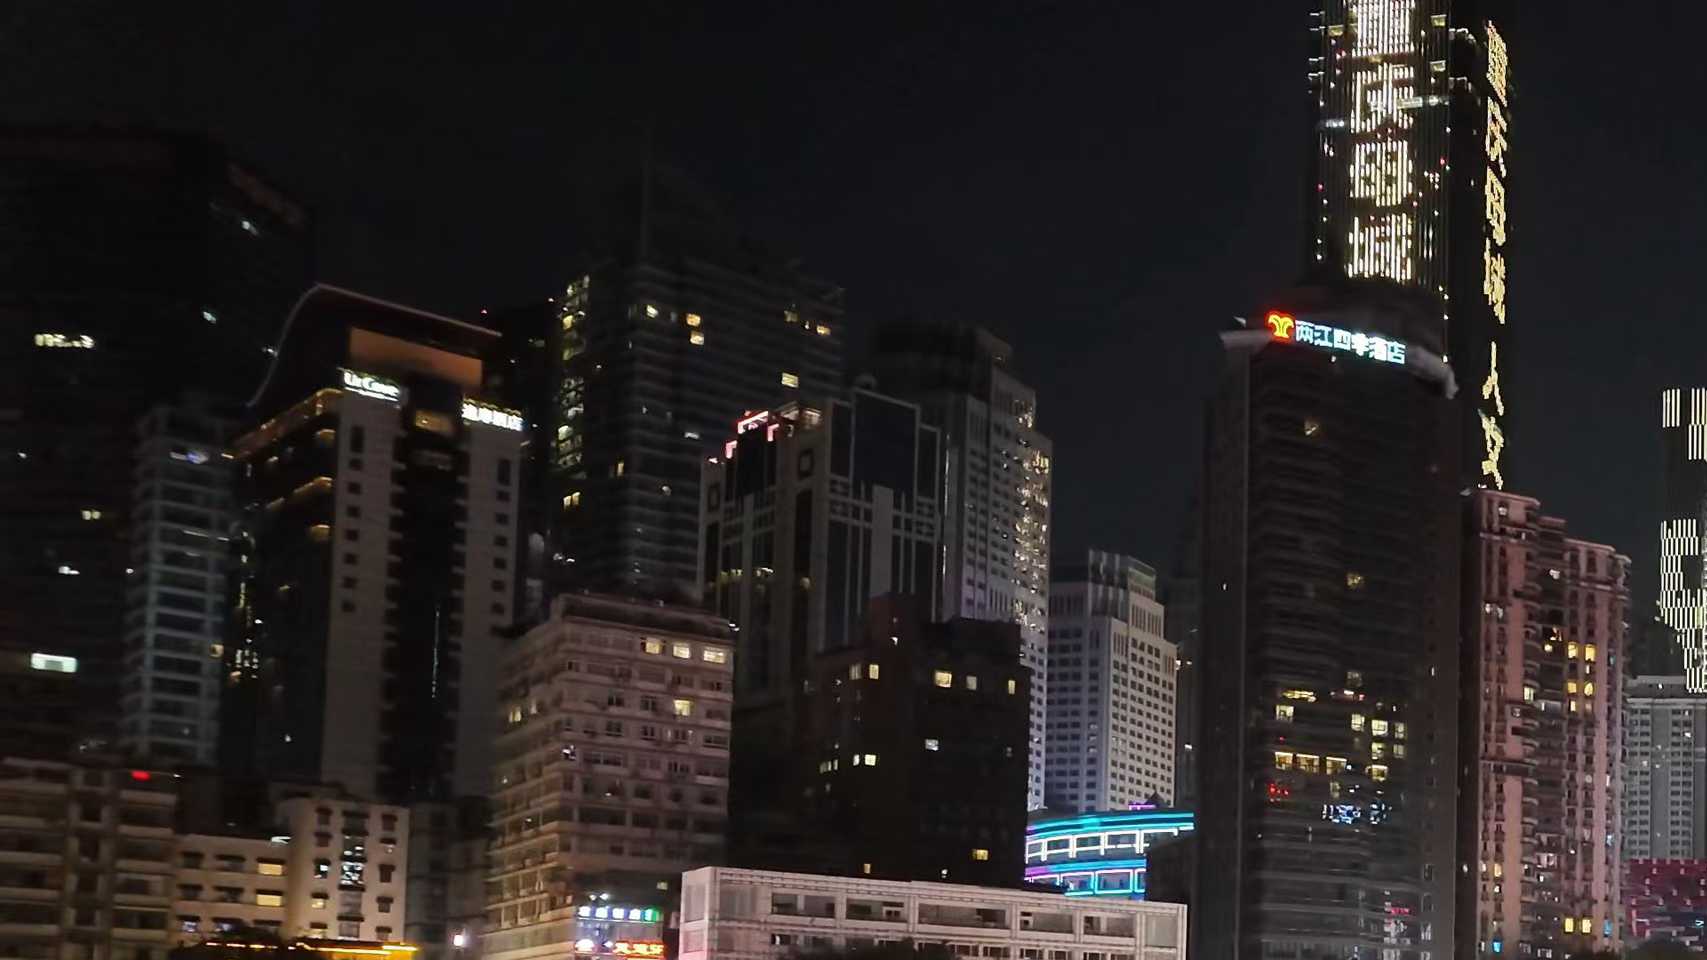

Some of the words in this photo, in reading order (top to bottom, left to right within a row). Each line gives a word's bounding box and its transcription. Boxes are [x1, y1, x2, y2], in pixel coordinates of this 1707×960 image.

[1295, 320, 1406, 364] 两江四季酒店
